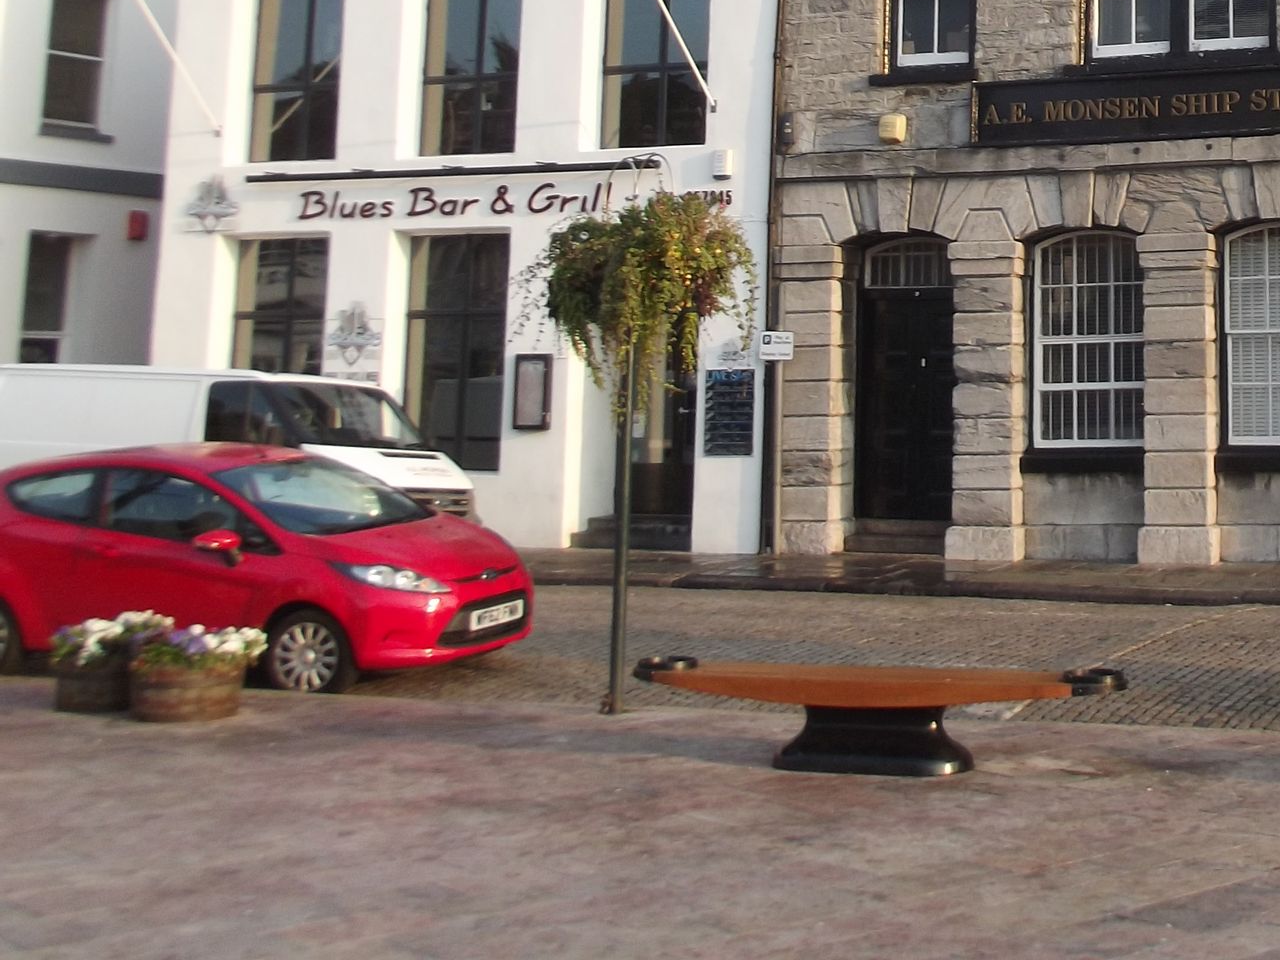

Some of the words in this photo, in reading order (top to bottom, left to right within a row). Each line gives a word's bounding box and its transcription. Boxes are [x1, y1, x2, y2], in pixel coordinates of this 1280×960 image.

[983, 102, 1033, 125] A.E.
[1043, 95, 1161, 122] MONSEN
[1170, 90, 1241, 116] SHIP
[297, 190, 394, 220] Blues
[407, 186, 481, 217] Bar
[490, 184, 514, 215] &
[527, 181, 613, 214] Grill
